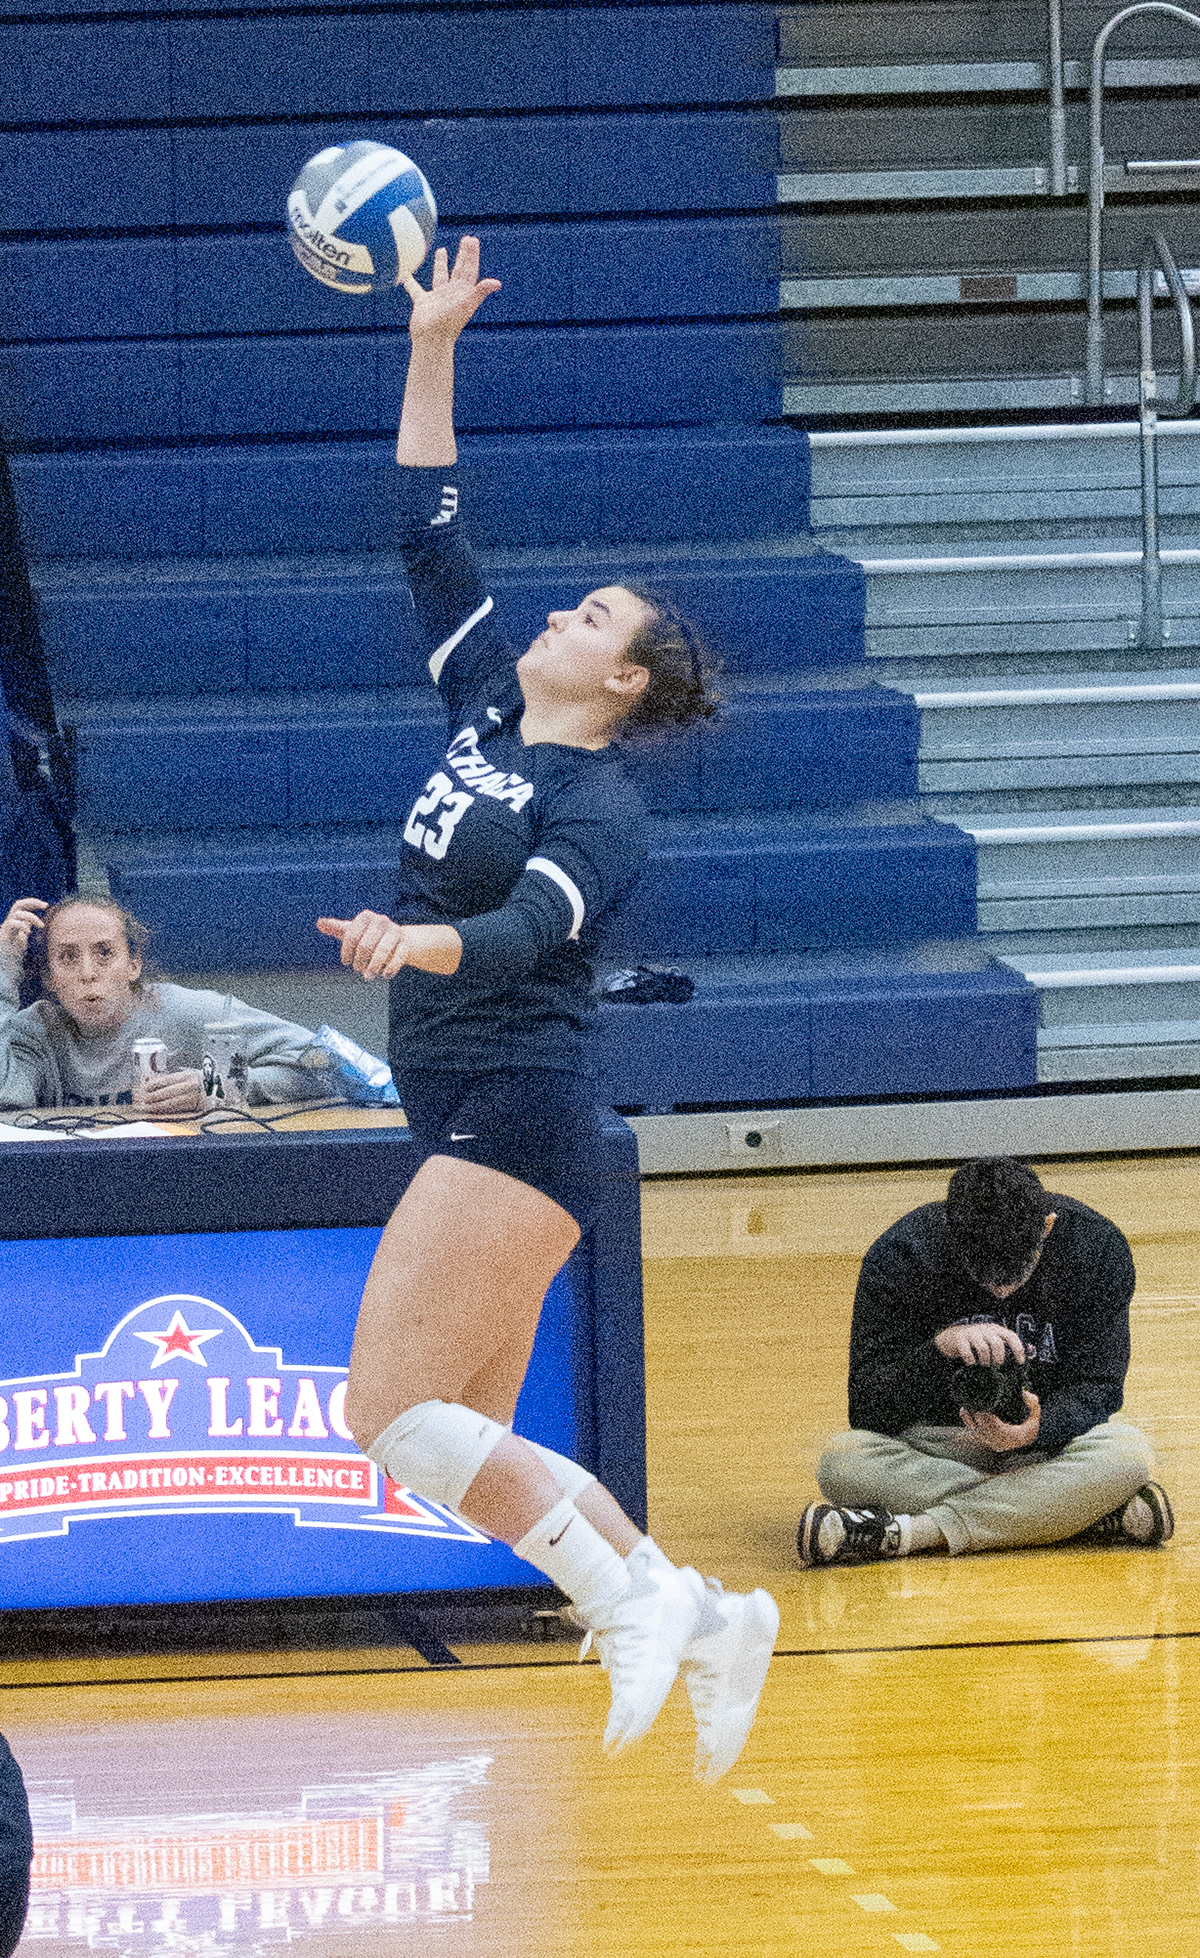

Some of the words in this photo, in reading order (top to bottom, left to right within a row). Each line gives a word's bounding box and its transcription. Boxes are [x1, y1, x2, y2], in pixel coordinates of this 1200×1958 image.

[403, 771, 475, 860] 23
[0, 1475, 70, 1502] PRIDE
[78, 1466, 205, 1493] TRADITION
[215, 1466, 364, 1490] EXCELLENCE
